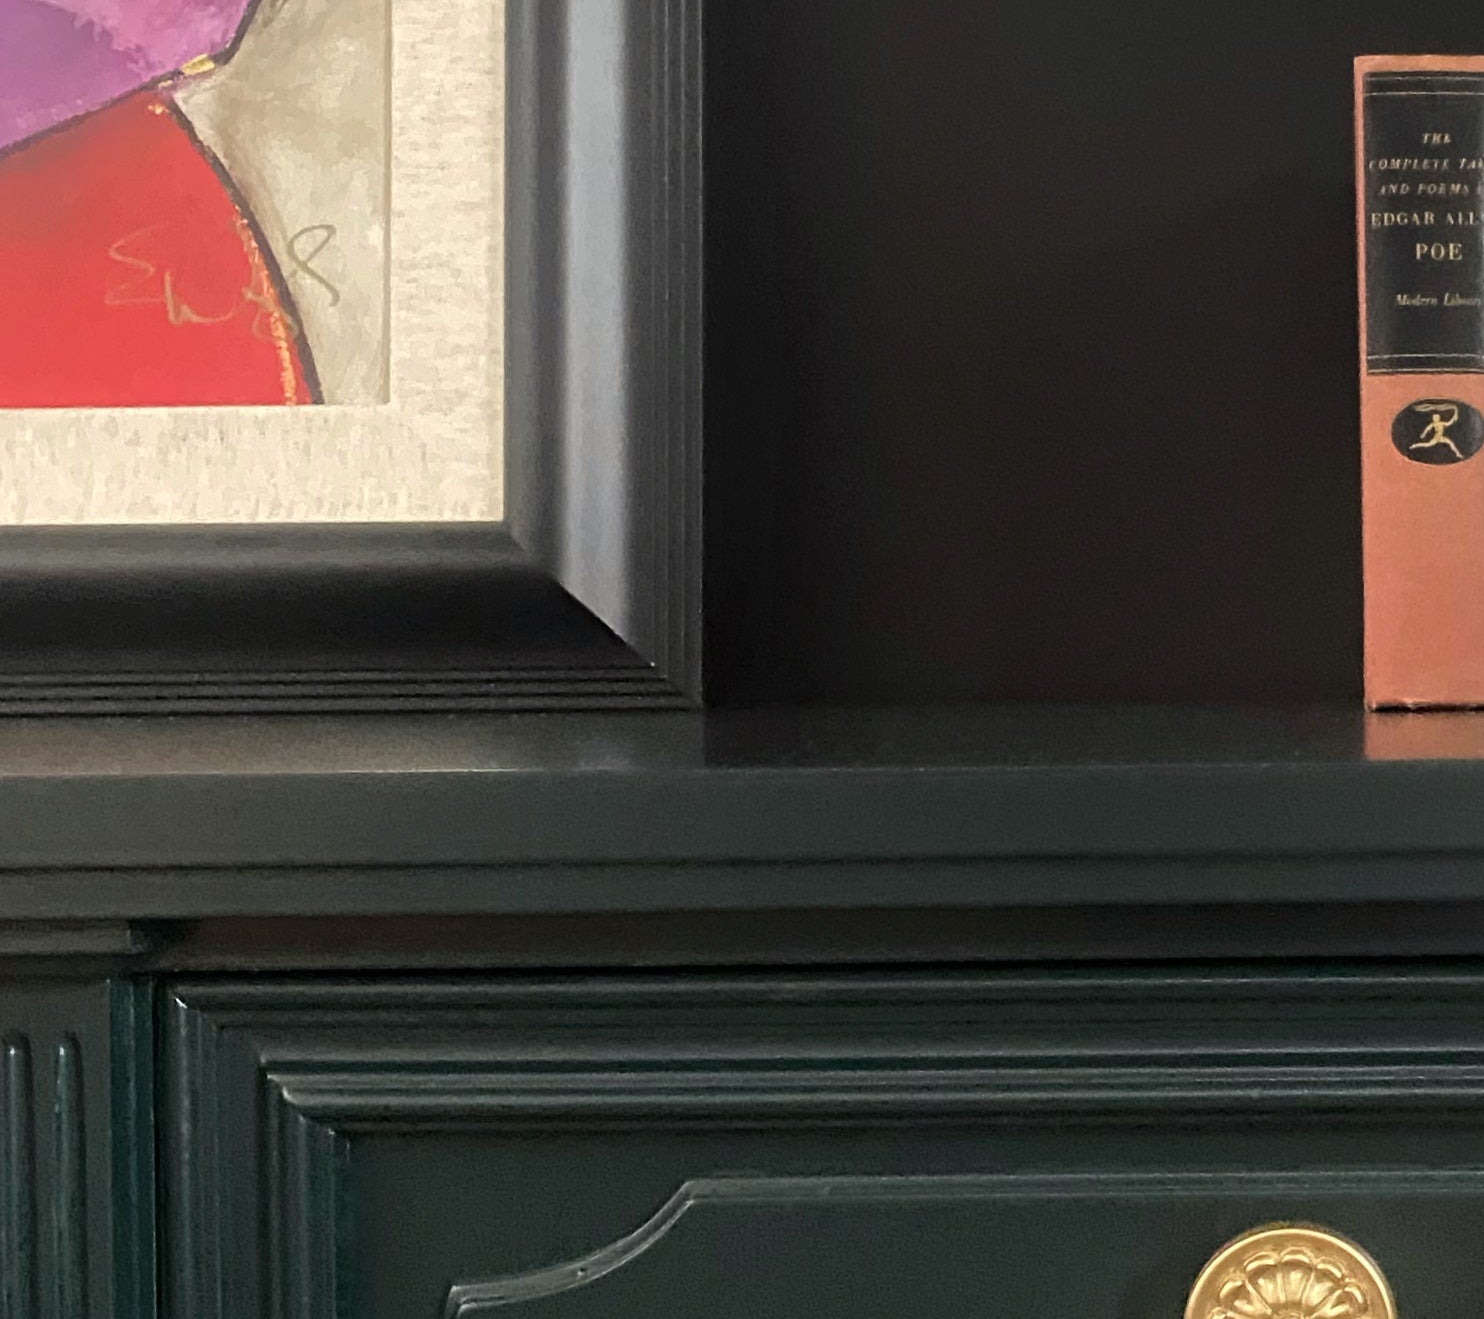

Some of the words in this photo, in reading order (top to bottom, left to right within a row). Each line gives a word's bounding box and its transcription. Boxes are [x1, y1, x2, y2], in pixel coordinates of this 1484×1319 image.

[1379, 183, 1410, 195] AND
[1418, 183, 1470, 196] POEMS
[1371, 211, 1435, 226] EDGAR
[1415, 242, 1463, 261] POE
